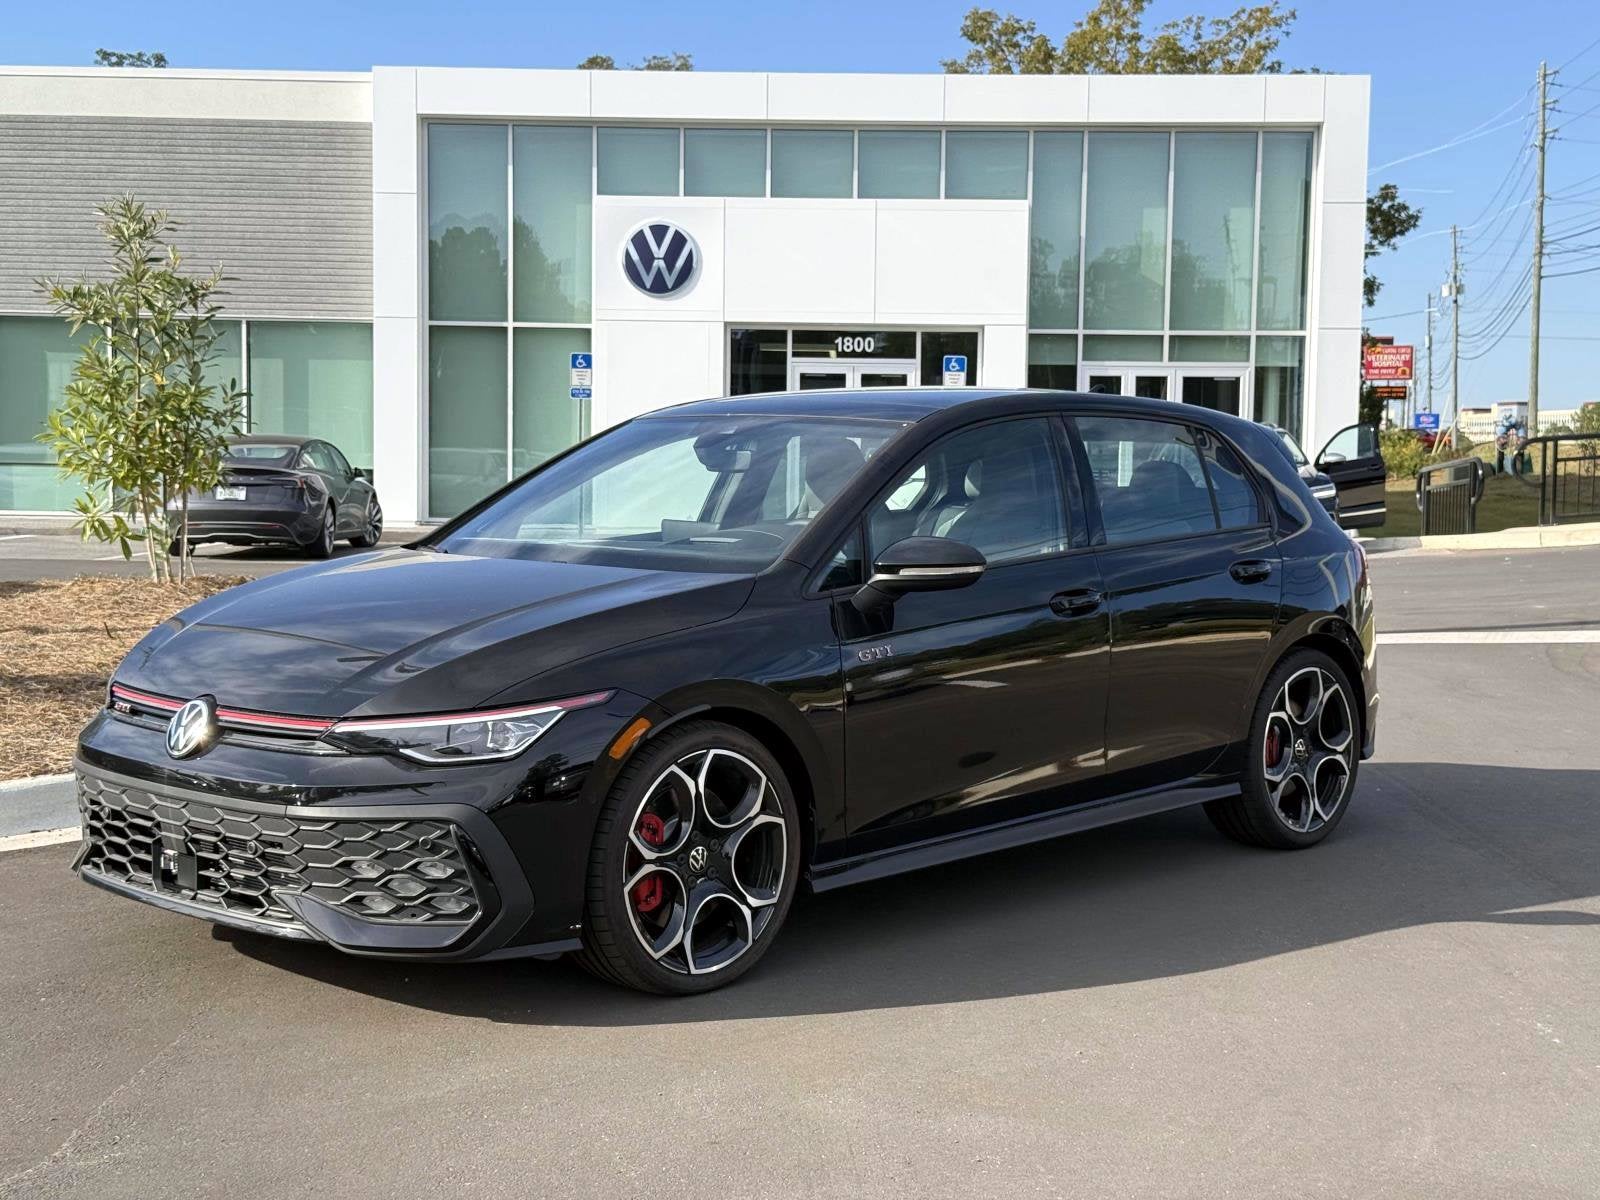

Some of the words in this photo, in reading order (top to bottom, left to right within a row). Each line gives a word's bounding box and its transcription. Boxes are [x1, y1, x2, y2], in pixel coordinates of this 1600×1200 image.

[835, 336, 875, 353] 1800
[1367, 354, 1410, 362] VETERINARY
[858, 645, 893, 661] GTI
